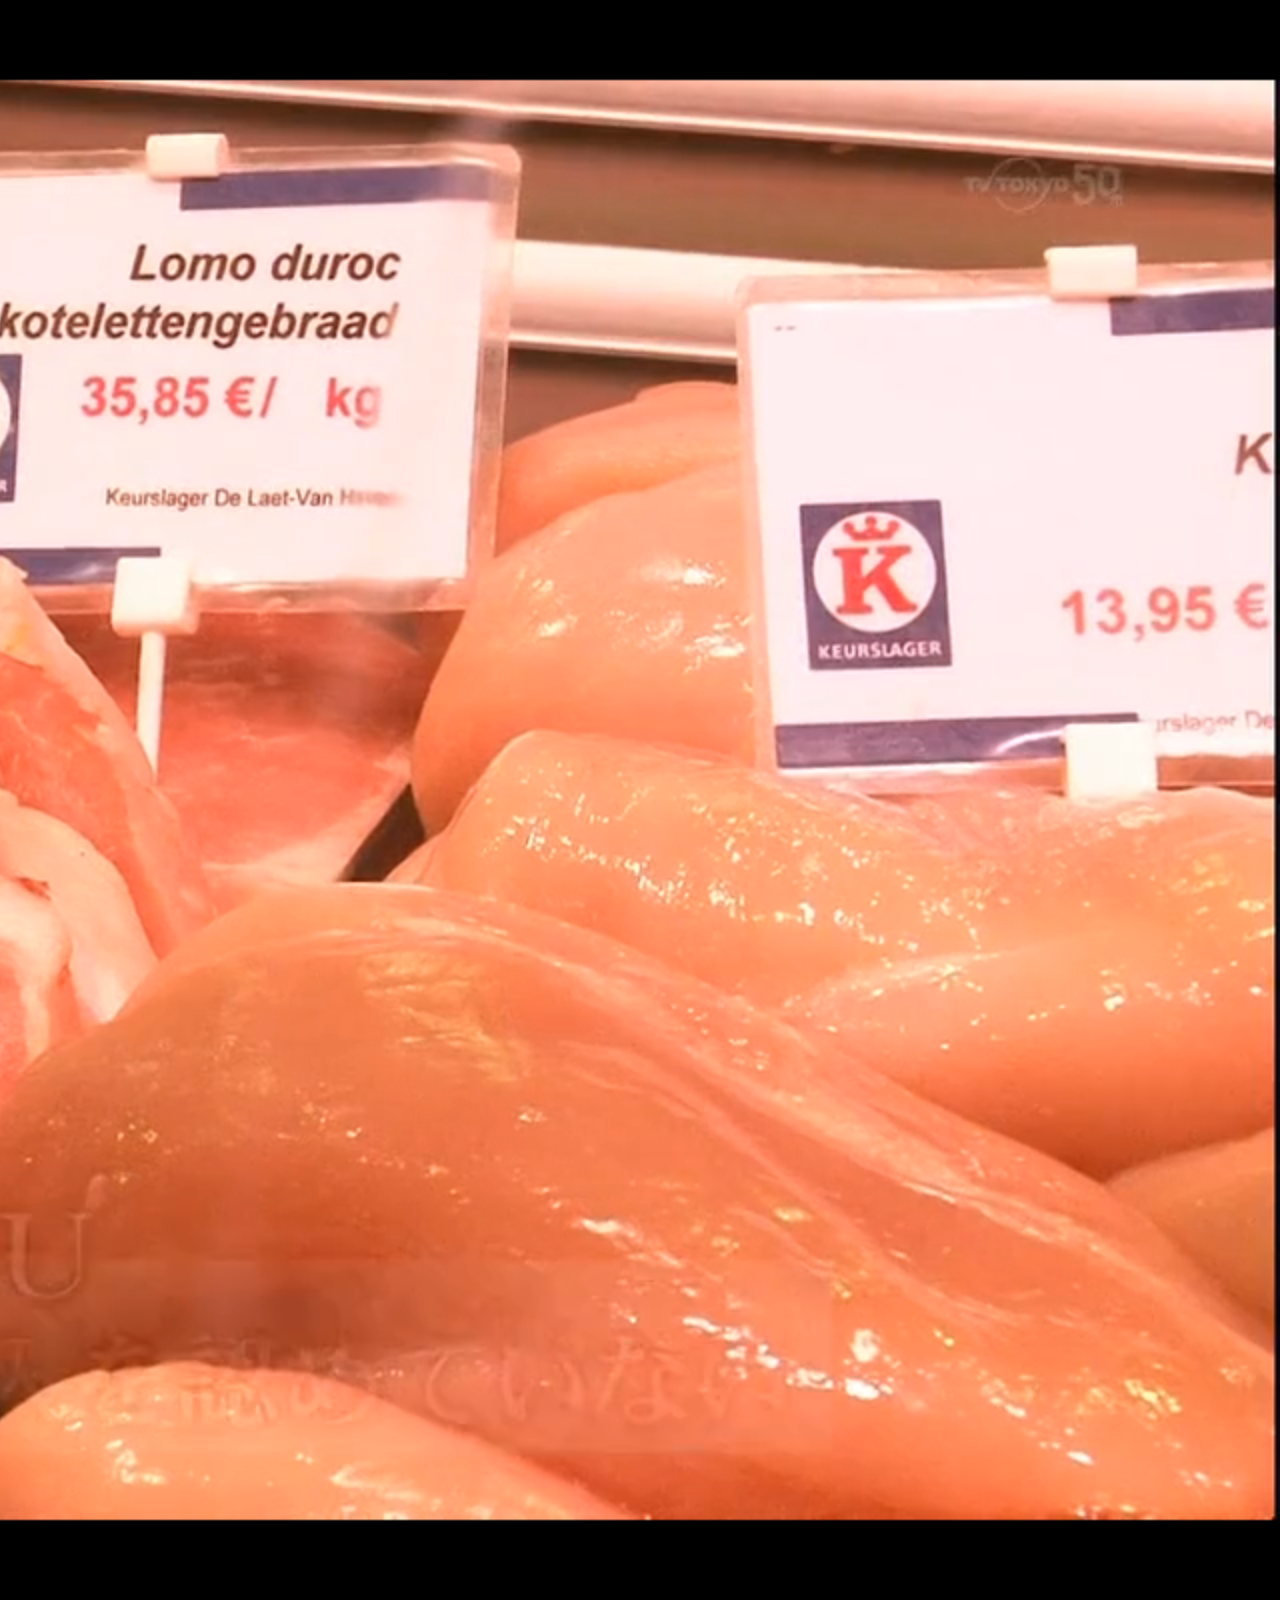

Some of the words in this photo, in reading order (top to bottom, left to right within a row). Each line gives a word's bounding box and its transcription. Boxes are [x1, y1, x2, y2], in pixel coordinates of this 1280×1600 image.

[130, 244, 257, 281] Lomo
[271, 244, 401, 281] duroc
[80, 376, 209, 425] 35,85
[325, 376, 383, 428] kg
[106, 487, 209, 511] Keurslager
[214, 488, 241, 506] De
[247, 488, 333, 507] Laet-Van
[1062, 586, 1217, 641] 13,95
[817, 640, 943, 660] KEURSLAGER
